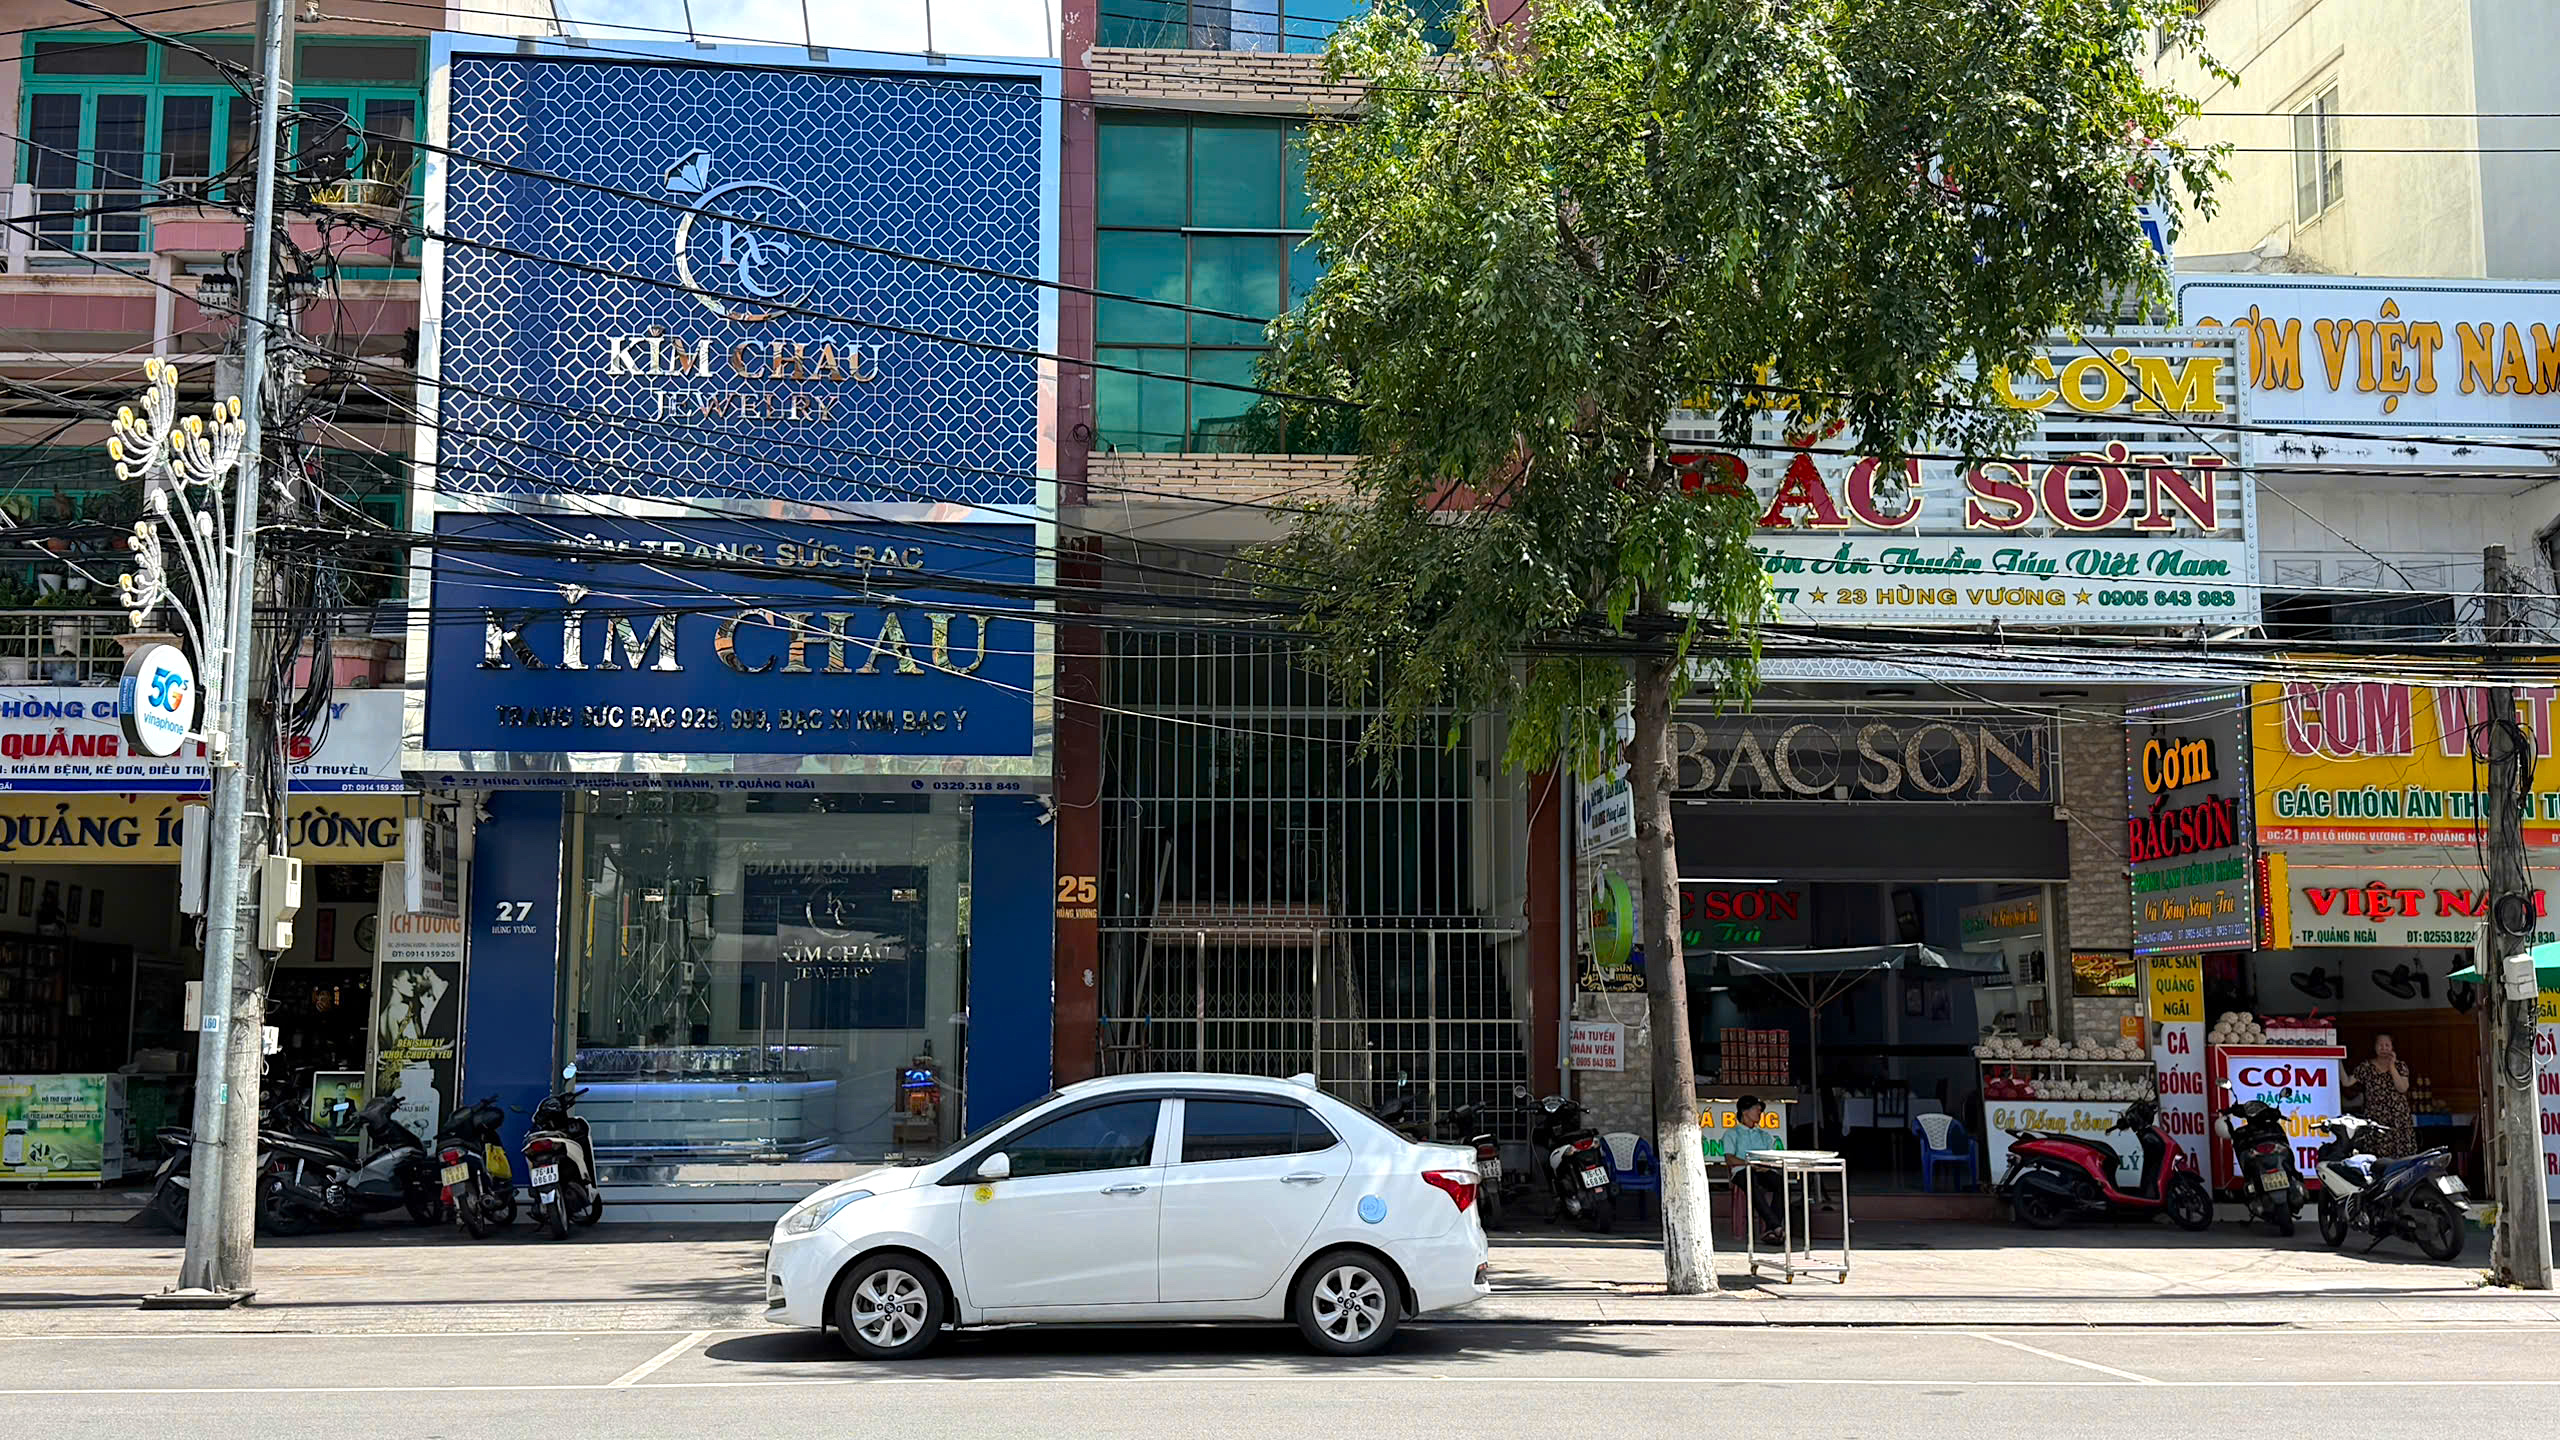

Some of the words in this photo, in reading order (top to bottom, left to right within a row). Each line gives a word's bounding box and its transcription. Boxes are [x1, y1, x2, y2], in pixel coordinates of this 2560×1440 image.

[732, 335, 883, 382] CHÂU
[2314, 297, 2443, 415] VIỆT
[2455, 321, 2560, 395] NAM
[2000, 347, 2227, 413] CƠM
[648, 390, 838, 422] JEWELRY
[1964, 440, 2227, 532] SƠN
[1752, 548, 1805, 575] ón
[1811, 542, 1872, 575] Ăn
[1880, 546, 1984, 576] Thuần
[1992, 549, 2060, 581] Túy
[2066, 549, 2140, 582] Việt
[2147, 549, 2231, 577] Nam
[1837, 588, 1868, 605] 23
[1876, 584, 1958, 606] HÙNG
[1966, 587, 2066, 606] VƯƠNG
[2099, 590, 2149, 607] 0905
[2154, 590, 2192, 607] 643
[2198, 591, 2236, 607] 983
[0, 694, 84, 718] HÒNG
[495, 704, 574, 727] TRANG
[630, 706, 677, 732] BẠC
[778, 708, 824, 736] BẠC
[144, 712, 184, 735] vinaphone
[2432, 685, 2558, 758] VIT
[1, 727, 119, 761] QUẢNG
[11, 763, 50, 775] KHÁM
[54, 764, 92, 777] BỆNH,
[149, 763, 180, 776] ĐIỀU
[316, 764, 369, 776] TRUYỀN
[2142, 738, 2212, 794] Cơm
[2277, 784, 2333, 818] CÁC
[2336, 784, 2400, 819] MÓN
[2406, 785, 2444, 820] ĂN
[0, 803, 141, 852] QUẢNG
[289, 804, 401, 848] ƯỜNG
[2179, 794, 2233, 854] SƠN
[2337, 831, 2366, 842] HÙNG
[2369, 831, 2406, 842] VƯƠNG
[1057, 875, 1098, 904] 25
[2303, 881, 2426, 923] VIỆT
[495, 901, 534, 922] 27
[1705, 888, 1801, 921] SƠN
[389, 911, 411, 934] ÍCH
[2301, 926, 2350, 943] TP.QUẢNG
[2353, 929, 2377, 943] NGÃI
[2406, 930, 2422, 943] ĐT:
[2423, 930, 2452, 943] 02553
[406, 950, 425, 958] 0914
[2156, 974, 2195, 996] QUẢNG
[2163, 1000, 2191, 1017] NGÃI
[2166, 1026, 2190, 1055] CÁ
[2535, 1028, 2557, 1056] CÁ
[2158, 1063, 2203, 1095] BỐNG
[2238, 1064, 2328, 1087] CƠM
[1992, 1107, 2017, 1130] Cá
[2020, 1107, 2068, 1134] Bống
[2160, 1107, 2205, 1136] SÔNG
